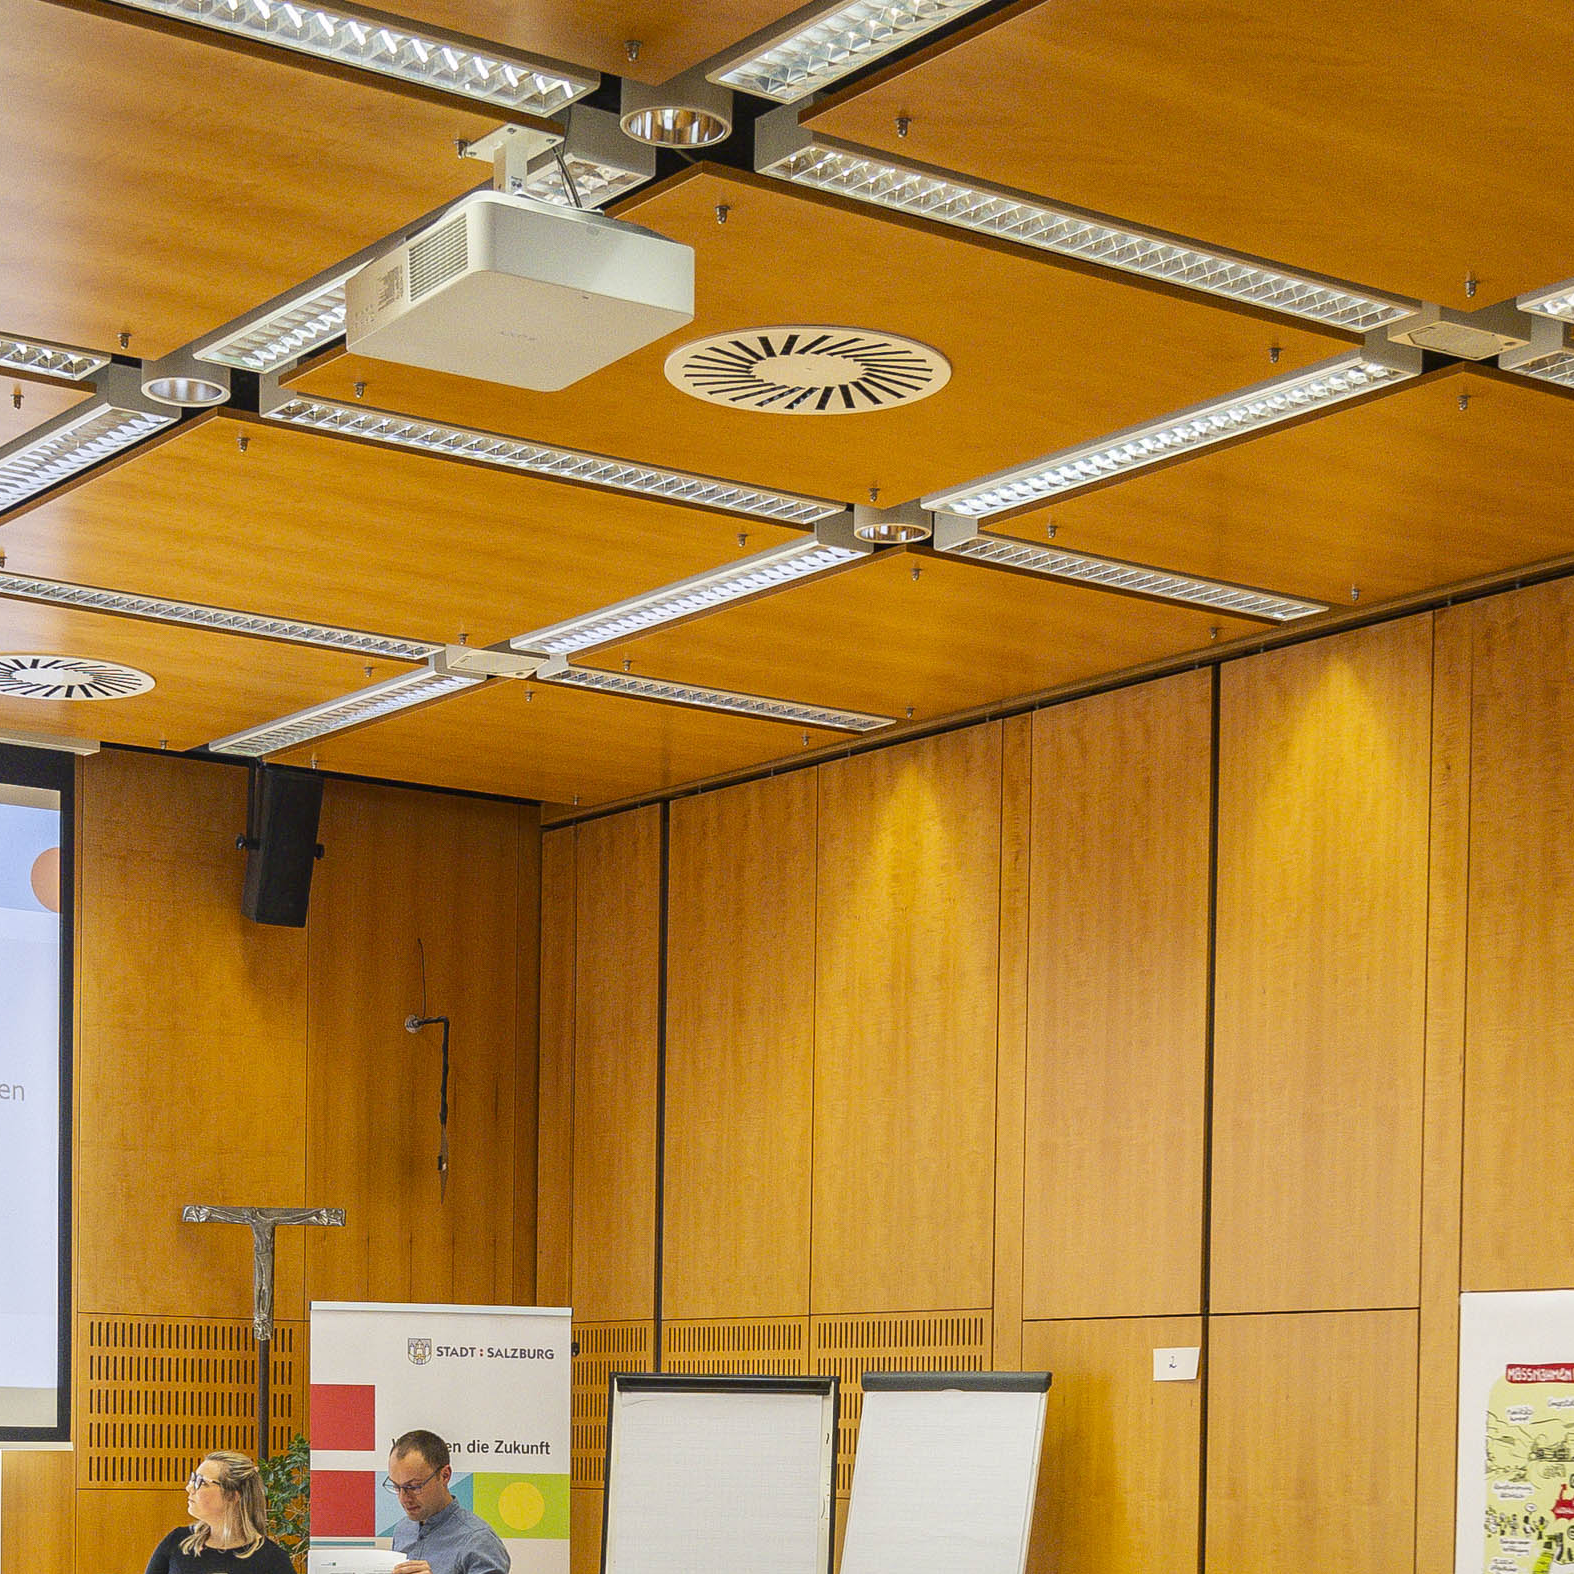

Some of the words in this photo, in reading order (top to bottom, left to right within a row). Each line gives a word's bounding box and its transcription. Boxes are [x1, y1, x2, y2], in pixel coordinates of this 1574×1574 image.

[436, 1346, 476, 1357] STADT
[487, 1347, 554, 1359] SALZBURG
[467, 1440, 489, 1453] die
[494, 1440, 551, 1455] Zukunft
